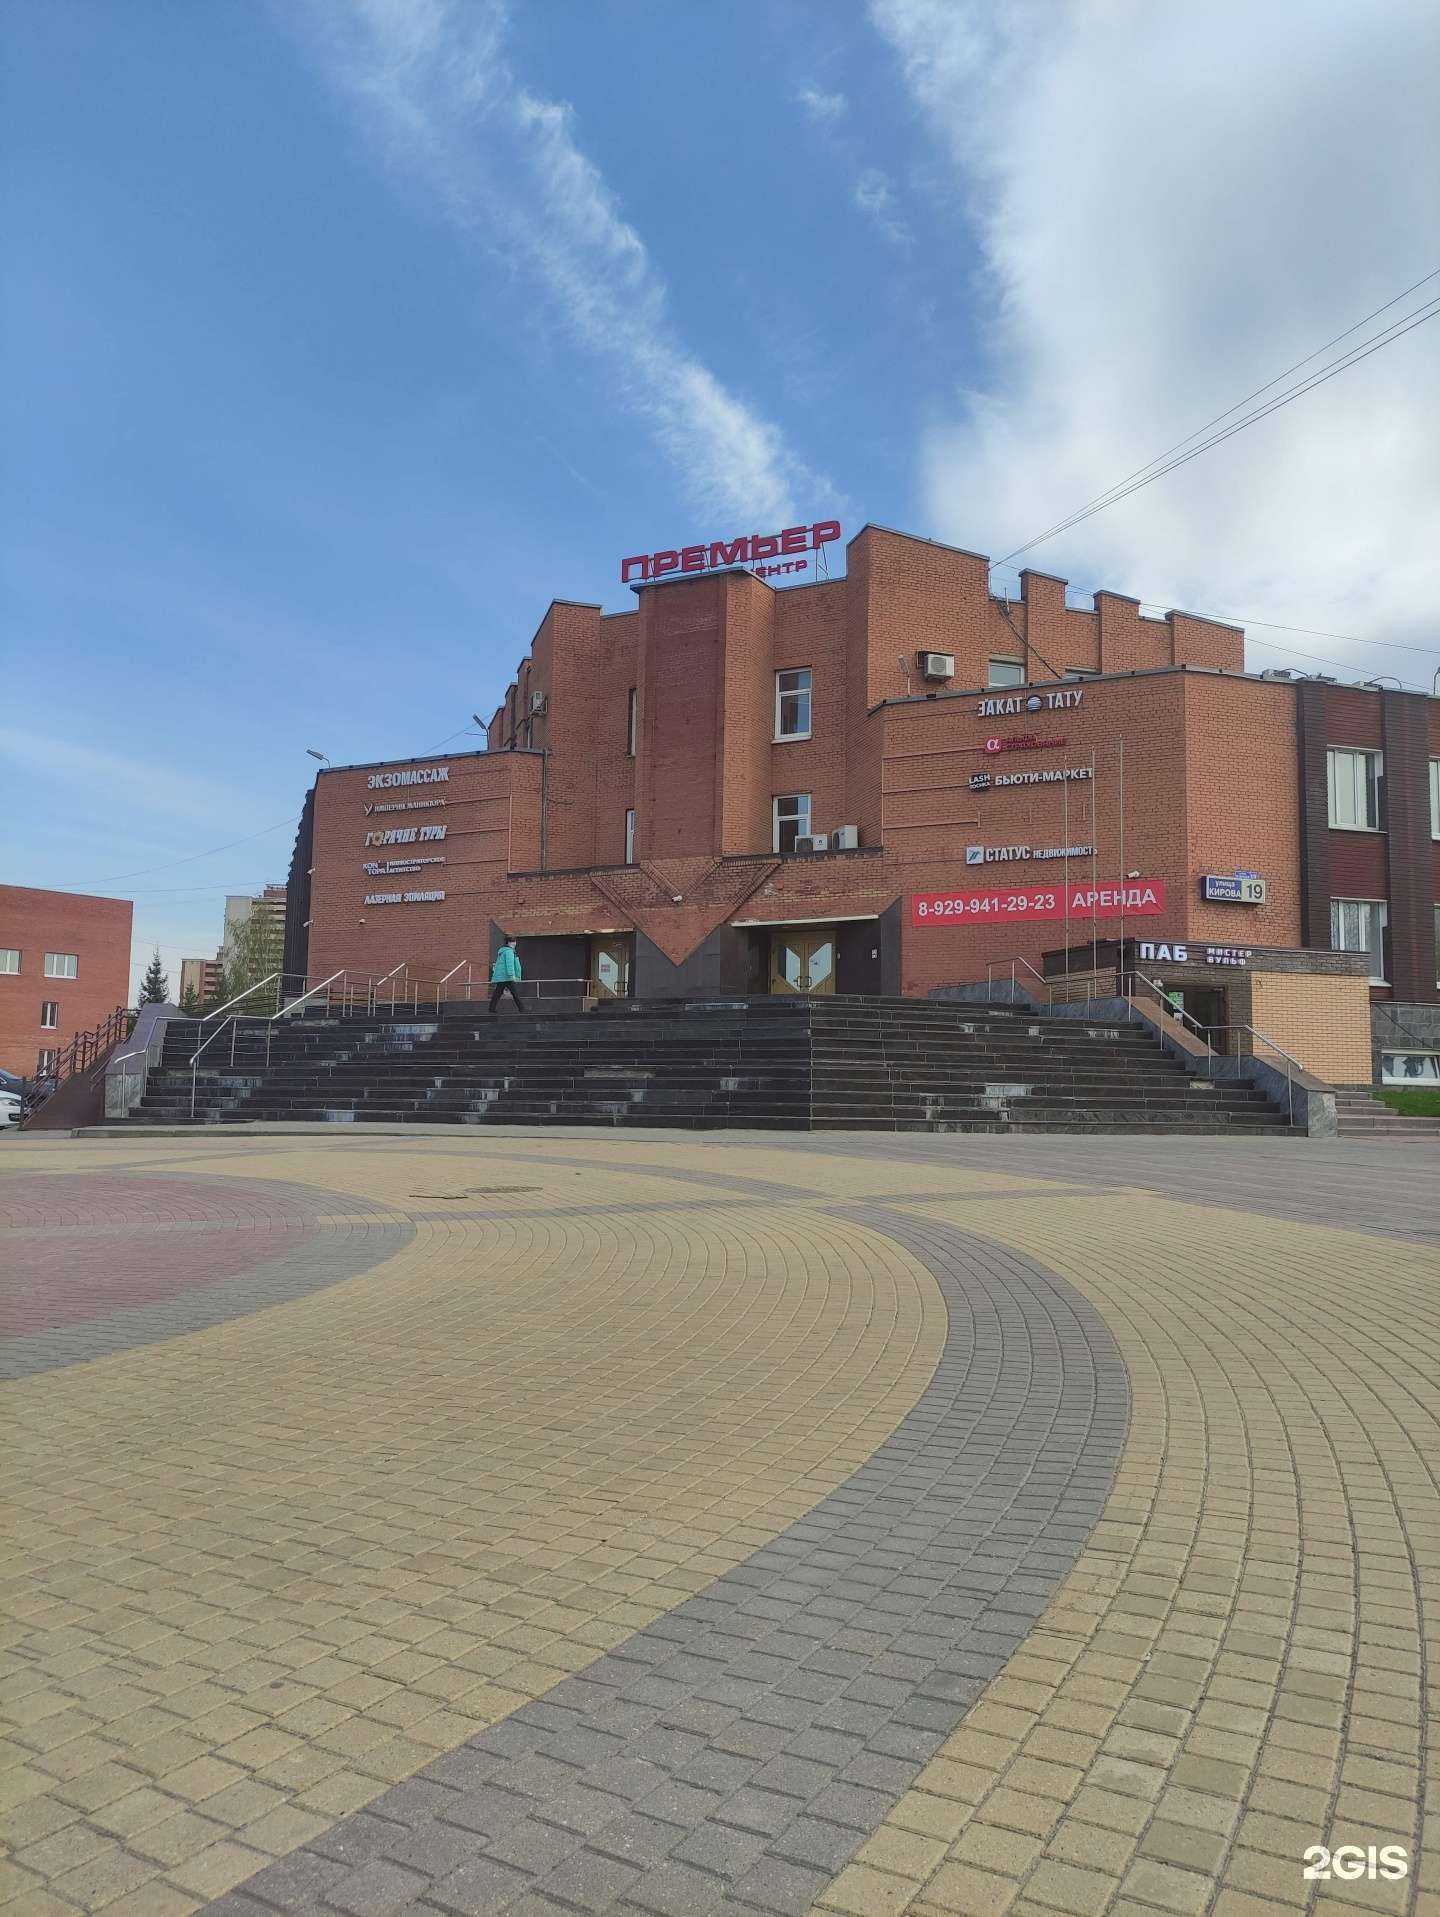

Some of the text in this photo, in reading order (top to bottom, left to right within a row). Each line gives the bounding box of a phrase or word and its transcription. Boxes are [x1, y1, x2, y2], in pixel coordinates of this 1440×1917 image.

[621, 520, 841, 583] ПРЕМЬЕР
[751, 559, 807, 578] ЕНТР
[1046, 690, 1083, 709] ТАТУ
[367, 767, 450, 789] ЭКЗОМАССАЖ
[995, 767, 1094, 786] БЬЮТИ-МАРКЕТ
[419, 825, 447, 842] ТУРЫ
[985, 846, 1098, 862] СТАТУС НЕДВИЖИМОСТЬ
[1209, 887, 1241, 898] КИРОВА
[1215, 880, 1235, 889] улица
[1247, 883, 1263, 899] 19
[364, 893, 402, 905] ЛАЗЕРНАЯ
[918, 887, 1157, 917] 8-929-941-29-23 АРЕНДА
[1139, 942, 1188, 962] ПАБ
[1206, 947, 1253, 958] МИСТЕР
[1206, 956, 1247, 966] ВУЛЬФ
